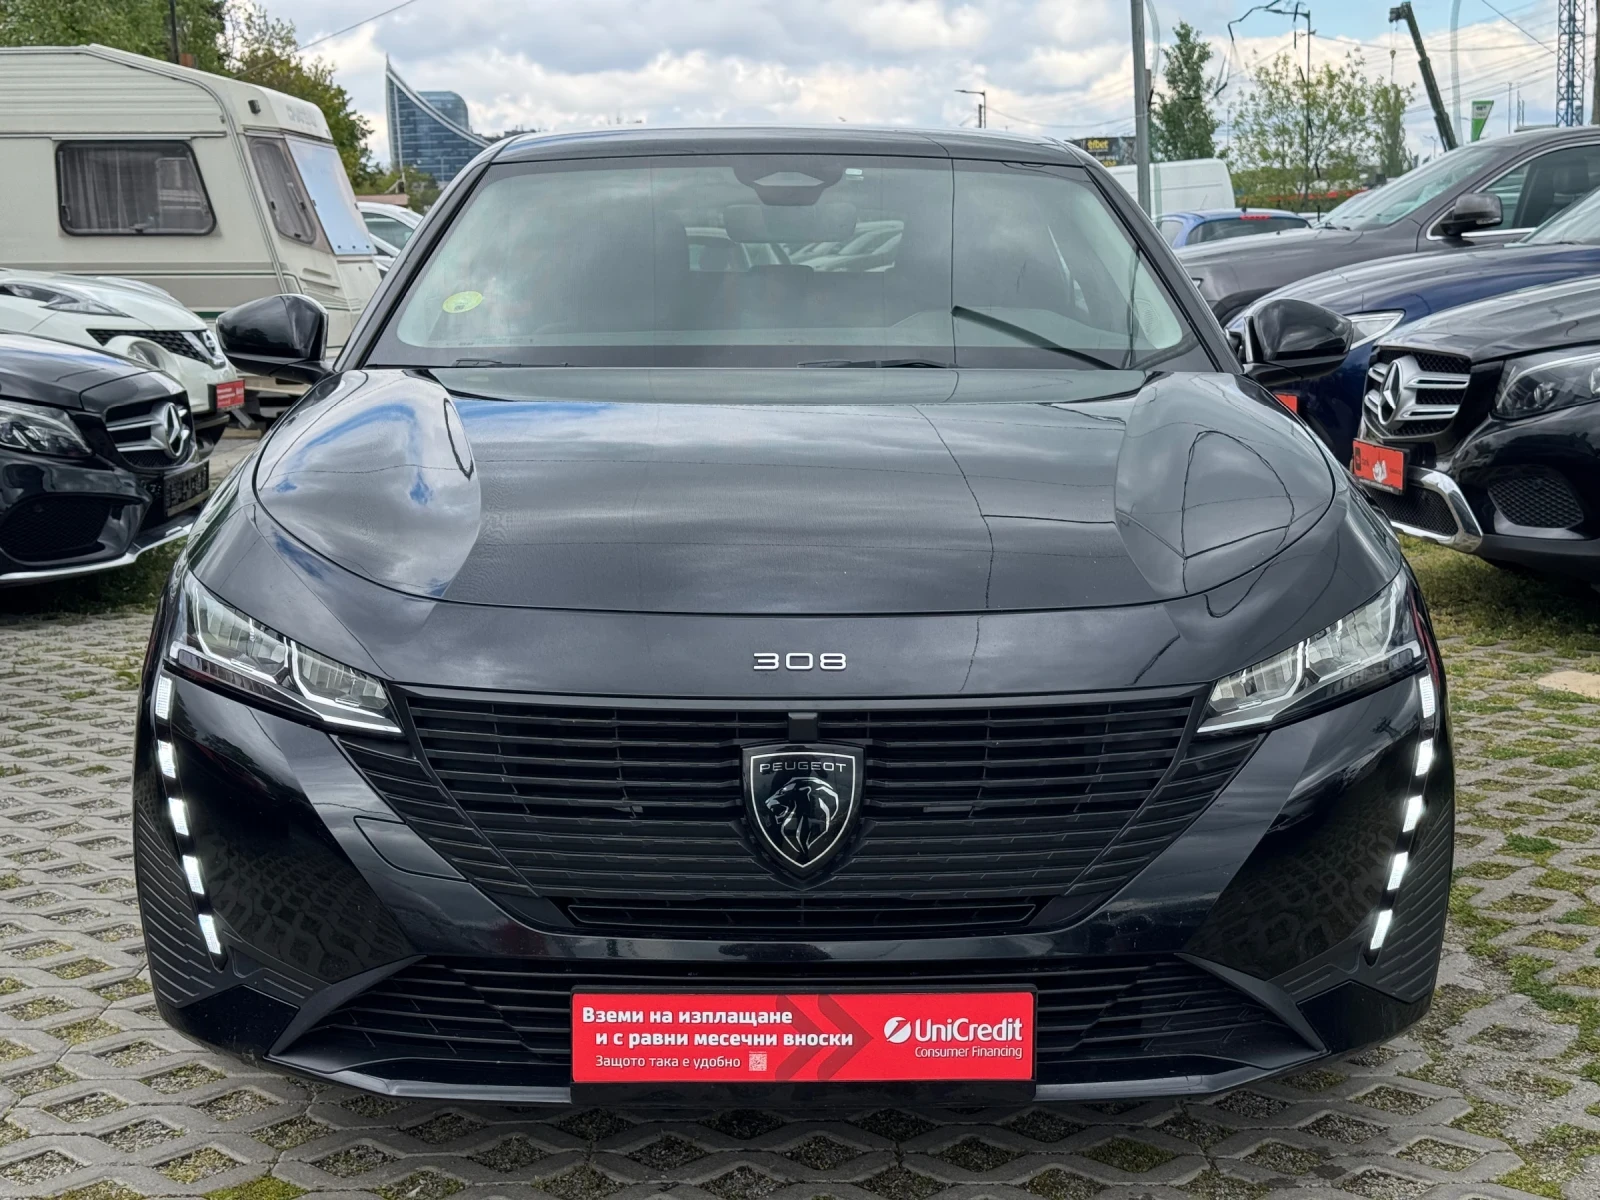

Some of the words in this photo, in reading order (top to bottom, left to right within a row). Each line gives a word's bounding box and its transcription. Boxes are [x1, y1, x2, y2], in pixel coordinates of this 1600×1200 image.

[753, 652, 847, 670] 308
[759, 761, 847, 773] PEUGEOT
[582, 1006, 644, 1023] Вземи
[649, 1010, 673, 1024] на
[678, 1010, 793, 1027] изплащане
[914, 1017, 1023, 1042] UniCredit
[595, 1032, 608, 1045] и
[613, 1032, 624, 1045] с
[628, 1032, 689, 1049] равни
[693, 1032, 778, 1046] месечни
[783, 1033, 853, 1046] вноски
[914, 1046, 970, 1058] Consumer
[972, 1044, 1023, 1060] Financing
[595, 1055, 646, 1069] Защото
[649, 1056, 679, 1067] така
[682, 1056, 690, 1067] е
[693, 1055, 741, 1070] удобно
